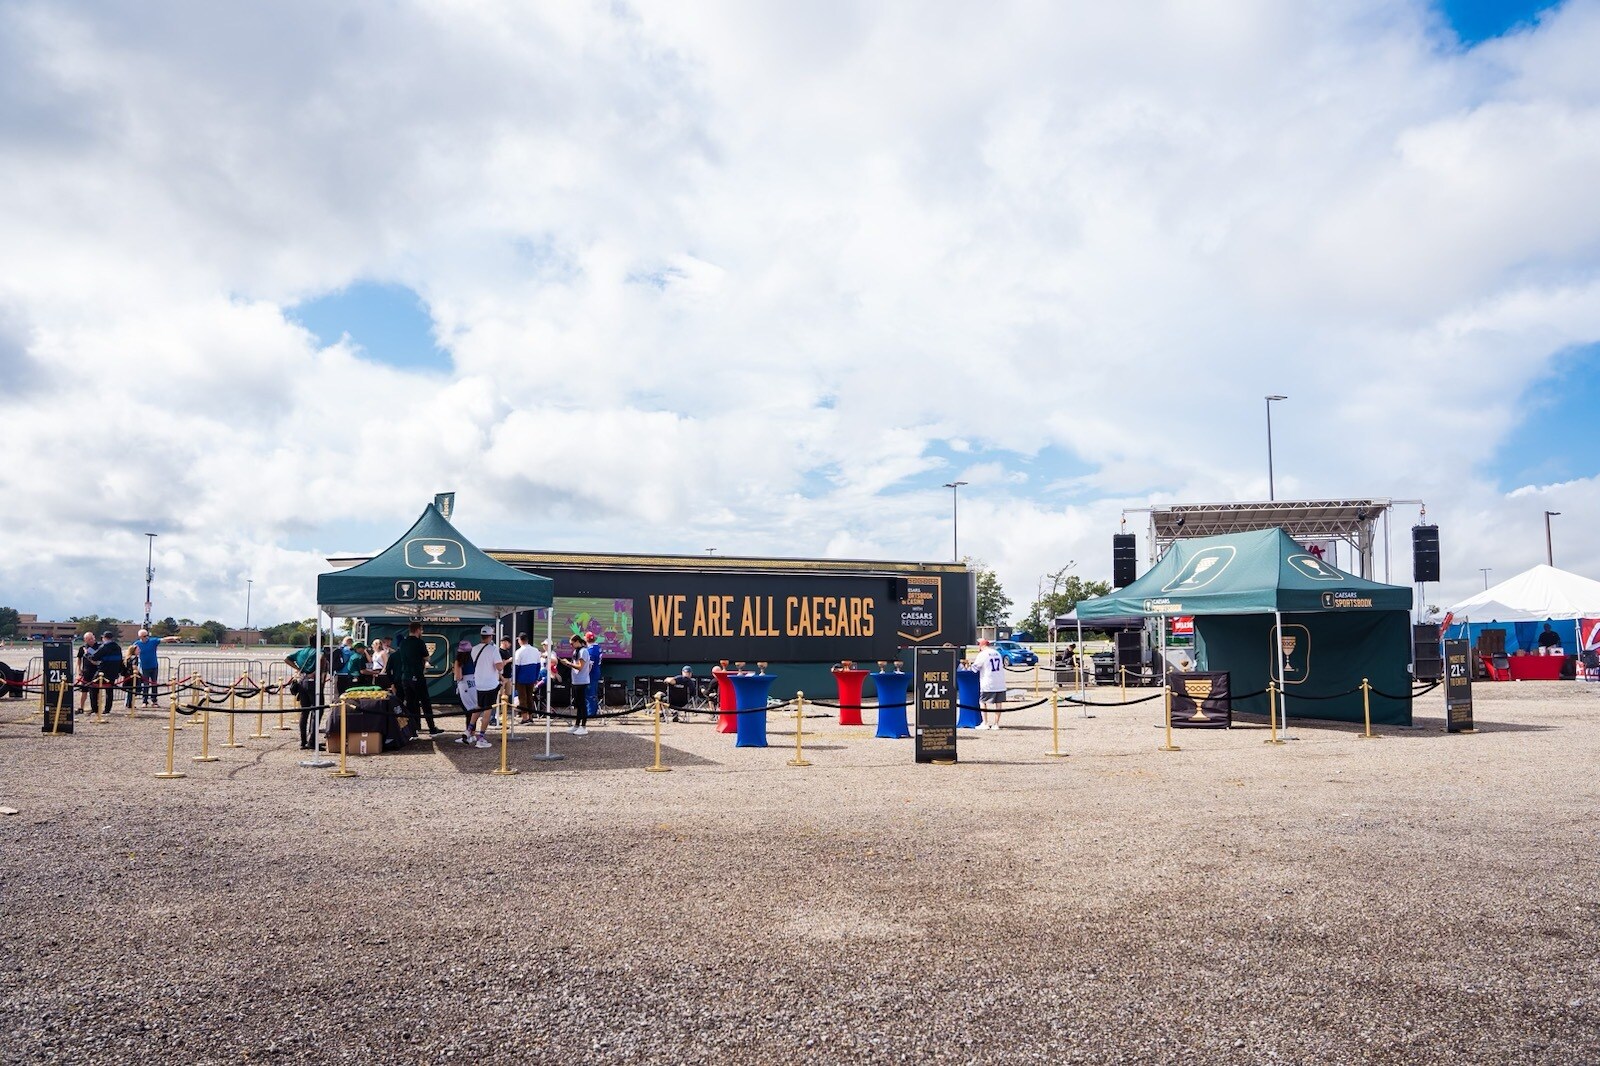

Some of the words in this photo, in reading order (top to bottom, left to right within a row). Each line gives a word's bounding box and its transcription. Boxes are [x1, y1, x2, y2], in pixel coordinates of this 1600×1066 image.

[417, 581, 456, 589] CAESARS
[417, 589, 482, 601] SPORTSBOOK
[1334, 599, 1372, 608] SPORTSBOOK
[649, 595, 687, 637] WE
[692, 595, 734, 637] ARE
[740, 596, 780, 637] ALL
[786, 596, 875, 637] CAESARS
[901, 612, 933, 620] CAESARS
[990, 658, 1001, 671] 17
[923, 671, 941, 681] MUST
[941, 671, 949, 681] BE
[1450, 664, 1465, 677] 21+
[925, 683, 948, 698] 21+
[922, 699, 931, 709] TO
[931, 699, 950, 709] ENTER
